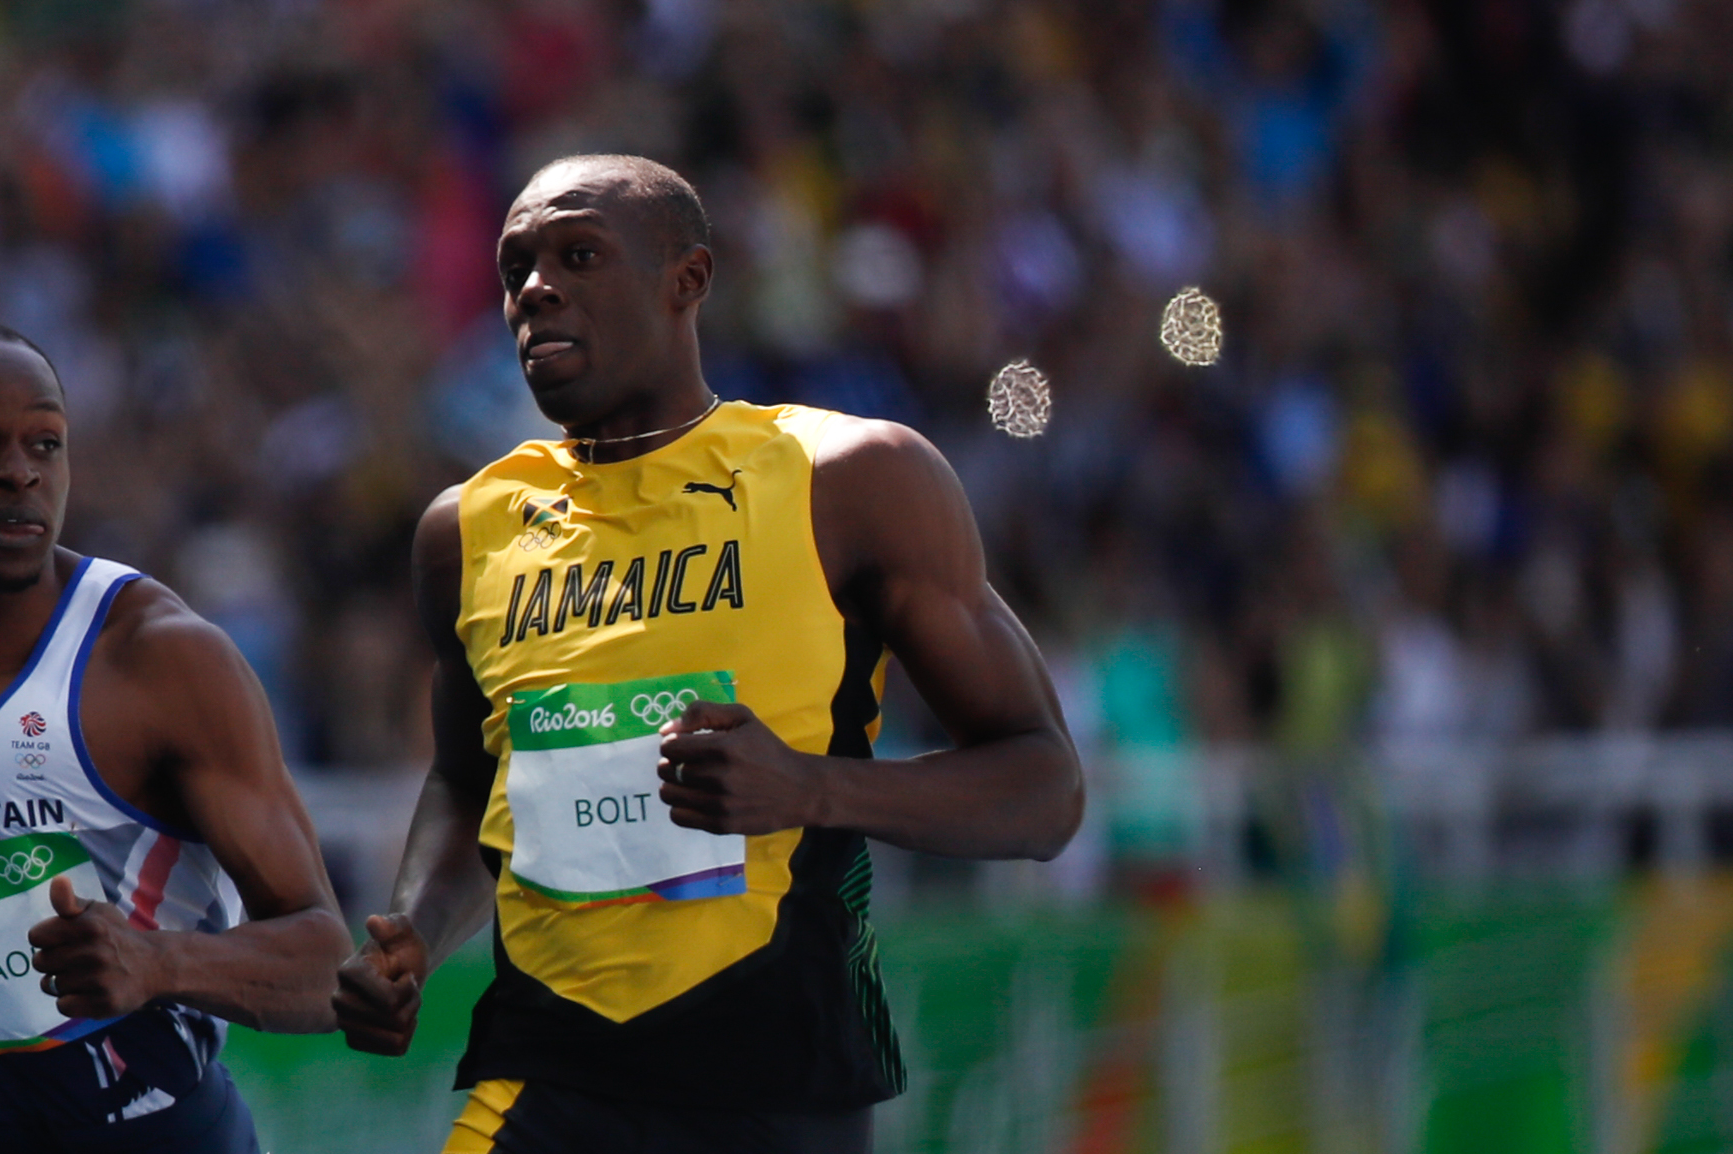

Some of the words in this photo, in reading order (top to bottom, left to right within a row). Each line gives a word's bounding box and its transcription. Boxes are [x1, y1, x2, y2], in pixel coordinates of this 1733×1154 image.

[499, 540, 744, 648] JAMAICA
[530, 702, 616, 734] Rio2016
[11, 740, 35, 750] TEAM
[37, 741, 51, 751] GB
[575, 793, 651, 827] BOLT
